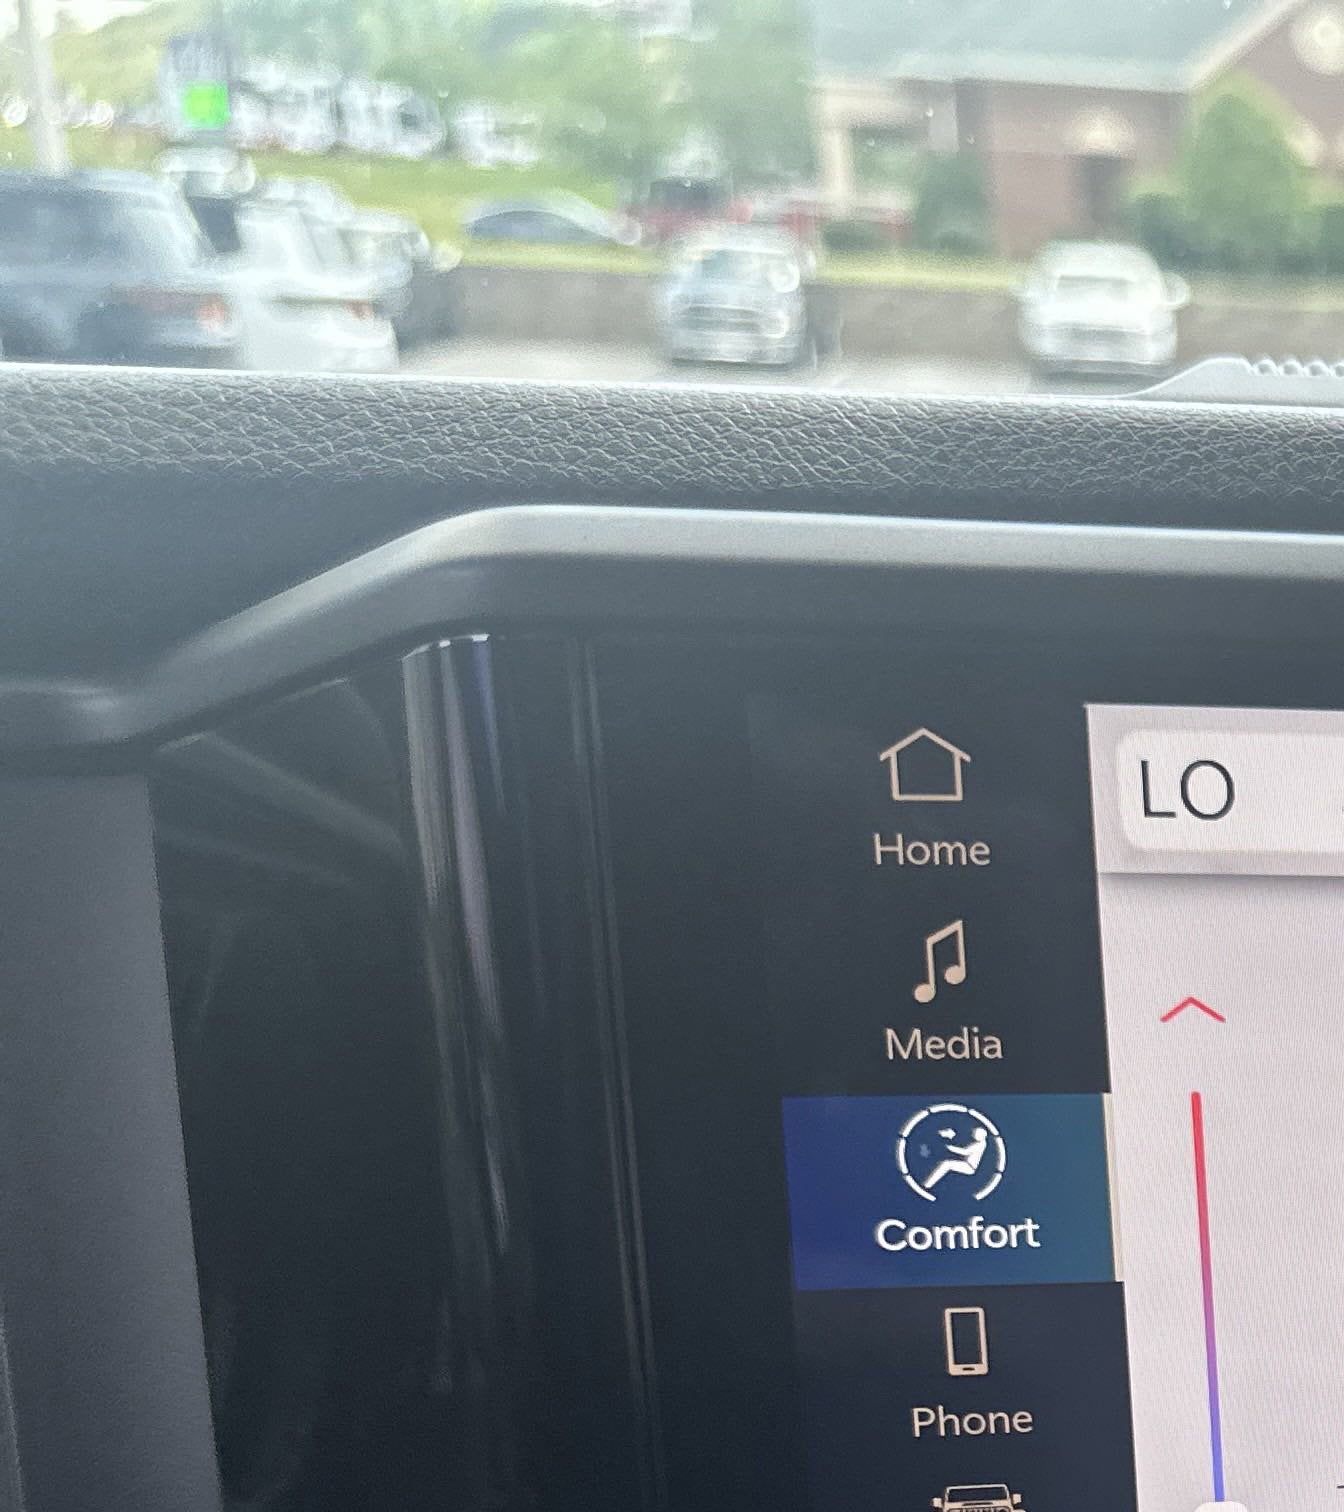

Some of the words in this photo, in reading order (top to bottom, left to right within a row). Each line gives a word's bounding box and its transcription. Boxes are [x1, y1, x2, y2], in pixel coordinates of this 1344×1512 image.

[1140, 759, 1236, 821] LO
[873, 833, 991, 866] Home
[885, 1027, 1004, 1061] Media
[875, 1217, 1041, 1252] Comfort
[911, 1405, 1034, 1438] Phone
